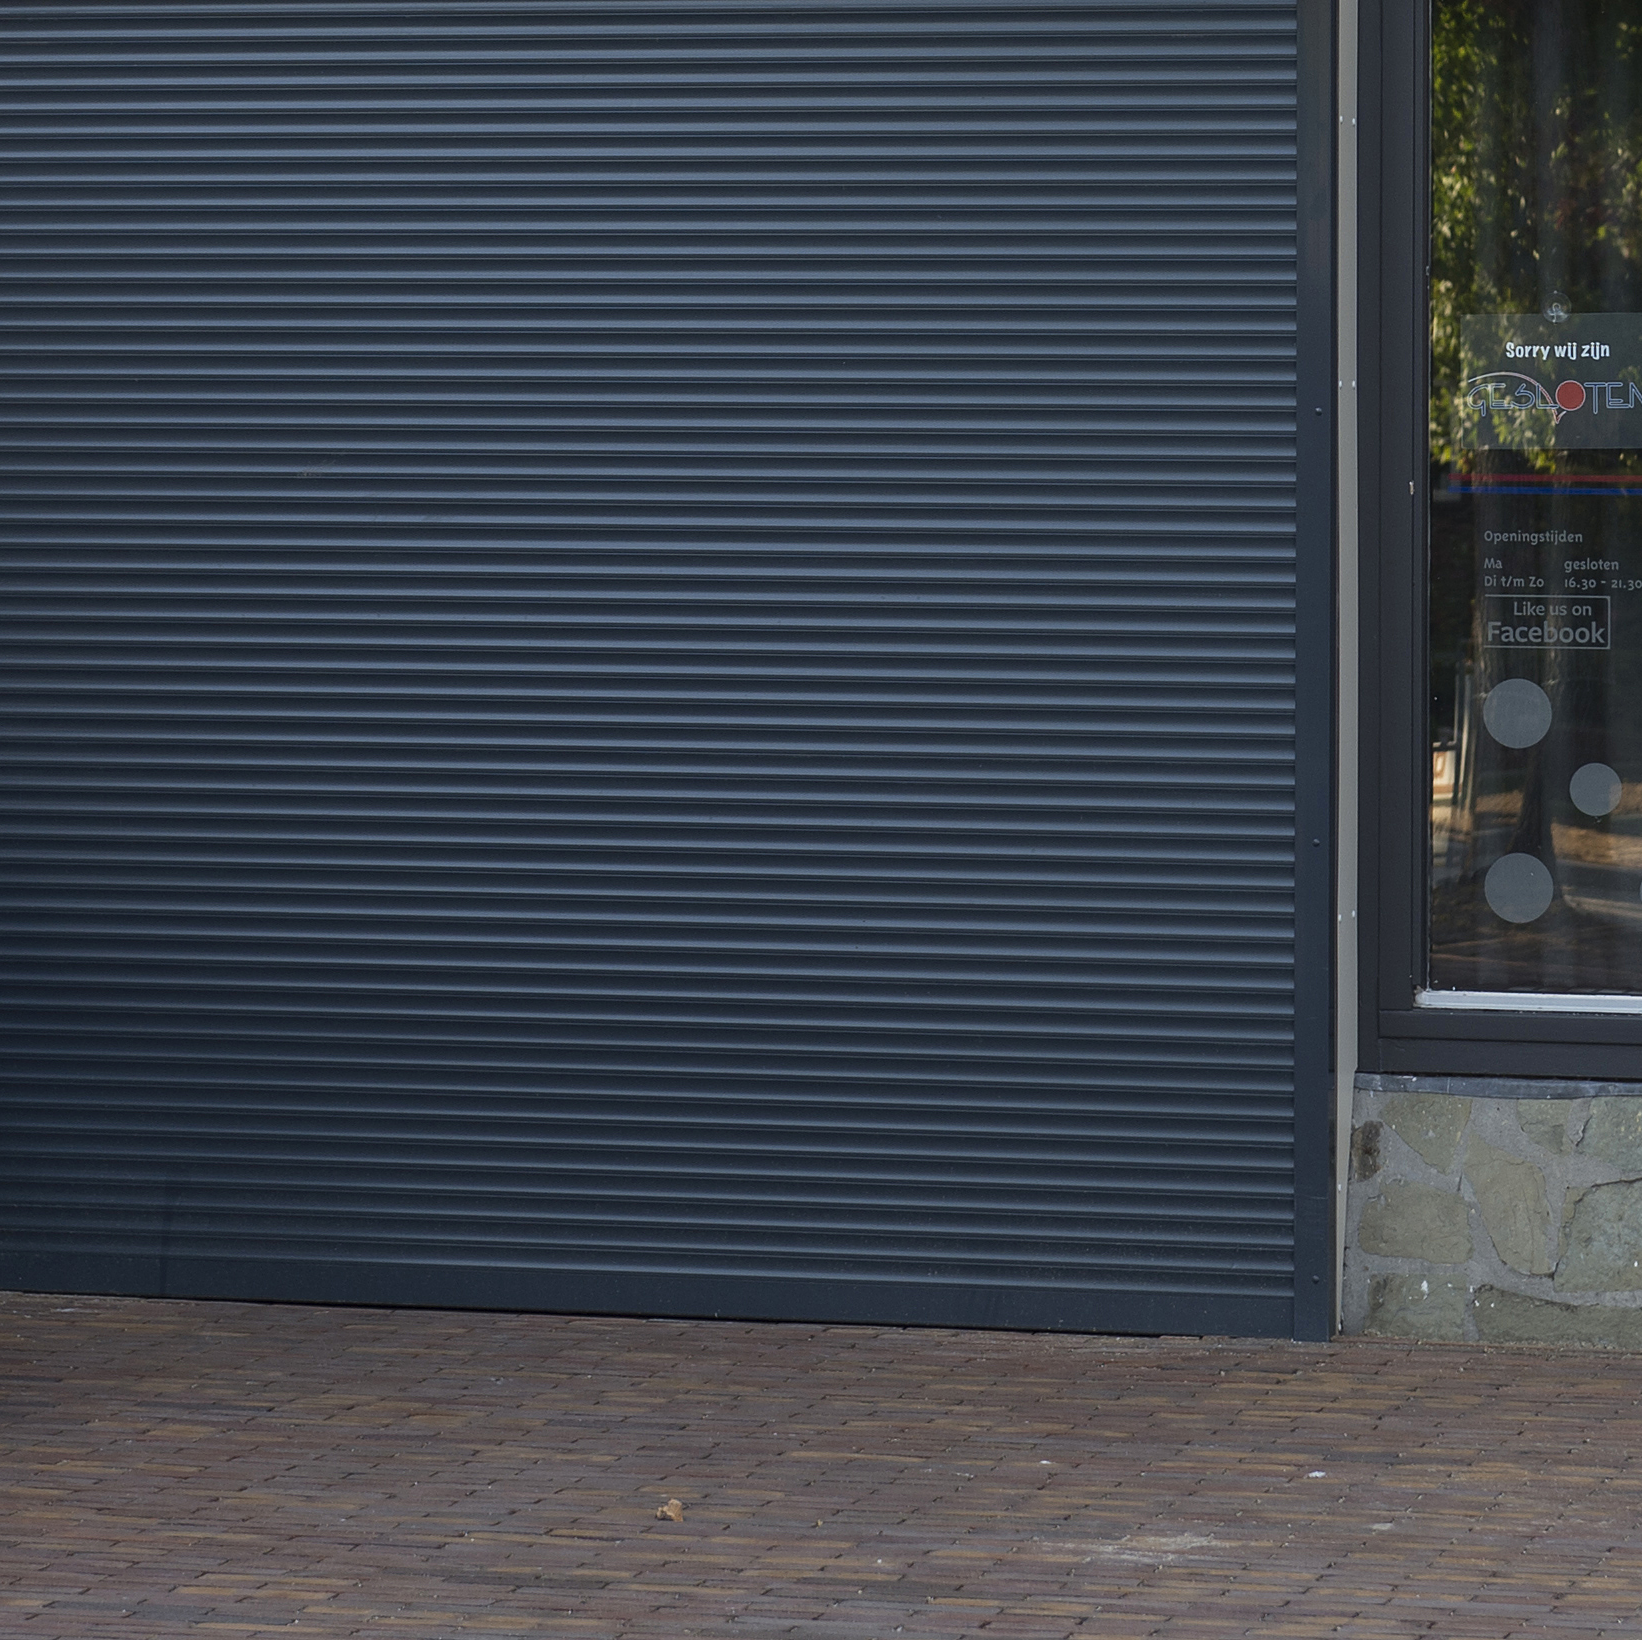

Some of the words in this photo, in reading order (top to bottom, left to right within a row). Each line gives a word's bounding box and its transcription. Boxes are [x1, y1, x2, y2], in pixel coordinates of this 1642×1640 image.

[1505, 342, 1551, 361] Sorry
[1553, 342, 1578, 360] wij
[1580, 342, 1610, 360] zijn
[1483, 530, 1583, 545] Openingstijden
[1483, 558, 1503, 569] Ma
[1564, 557, 1619, 573] gesloten
[1484, 576, 1497, 587] Di
[1500, 575, 1525, 588] t/m
[1528, 576, 1545, 588] Zo
[1564, 577, 1597, 590] 16.30
[1611, 579, 1642, 591] 21.30
[1513, 601, 1545, 616] Like
[1549, 604, 1567, 616] us
[1571, 604, 1592, 616] on
[1487, 621, 1605, 643] Facebook
